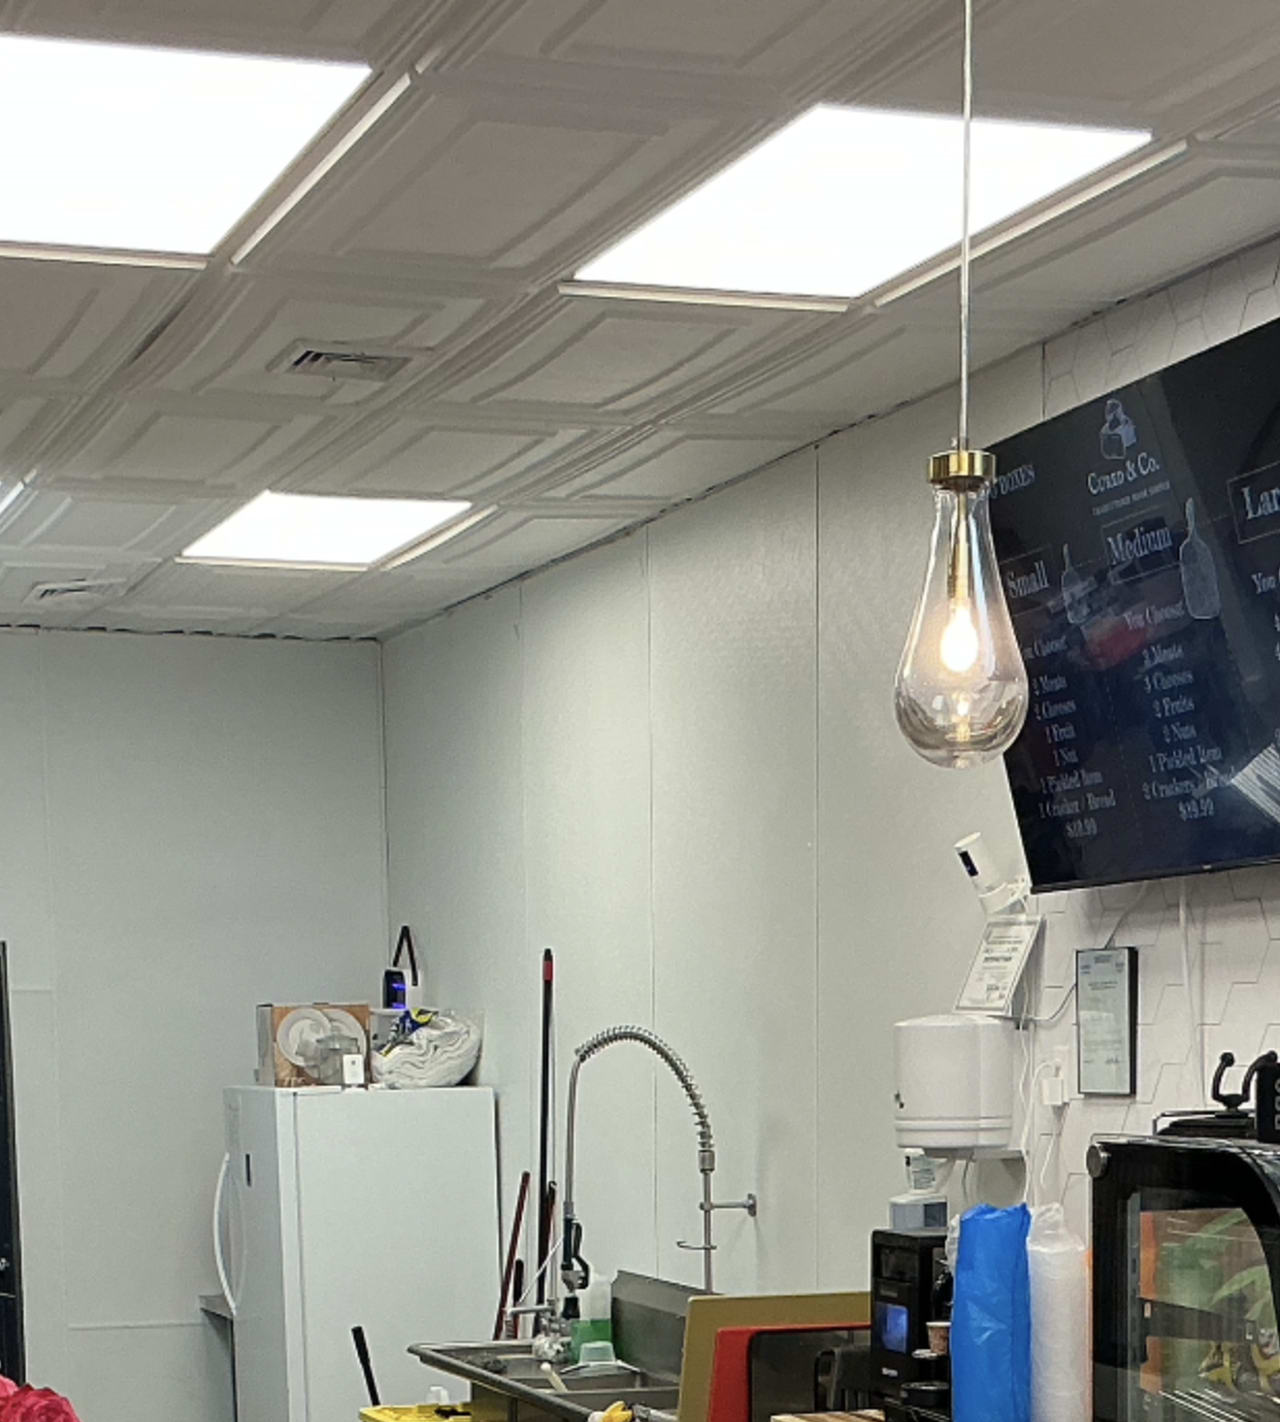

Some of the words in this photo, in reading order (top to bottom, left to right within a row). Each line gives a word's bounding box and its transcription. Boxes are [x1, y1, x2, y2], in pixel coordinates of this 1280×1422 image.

[999, 462, 1034, 494] BOXES
[1124, 458, 1136, 479] &
[1106, 517, 1172, 566] Medium
[1007, 557, 1048, 599] Small
[1252, 570, 1277, 593] You
[1152, 668, 1193, 692] Cheeses
[1042, 697, 1075, 718] Cheeses
[1162, 694, 1193, 717] Fruits
[1051, 721, 1075, 741] Fruit
[1170, 722, 1195, 742] Nuts
[1059, 748, 1078, 765] Nut
[1155, 747, 1196, 772] Pickled
[1047, 772, 1080, 793] Pickled
[1086, 790, 1115, 810] Bread
